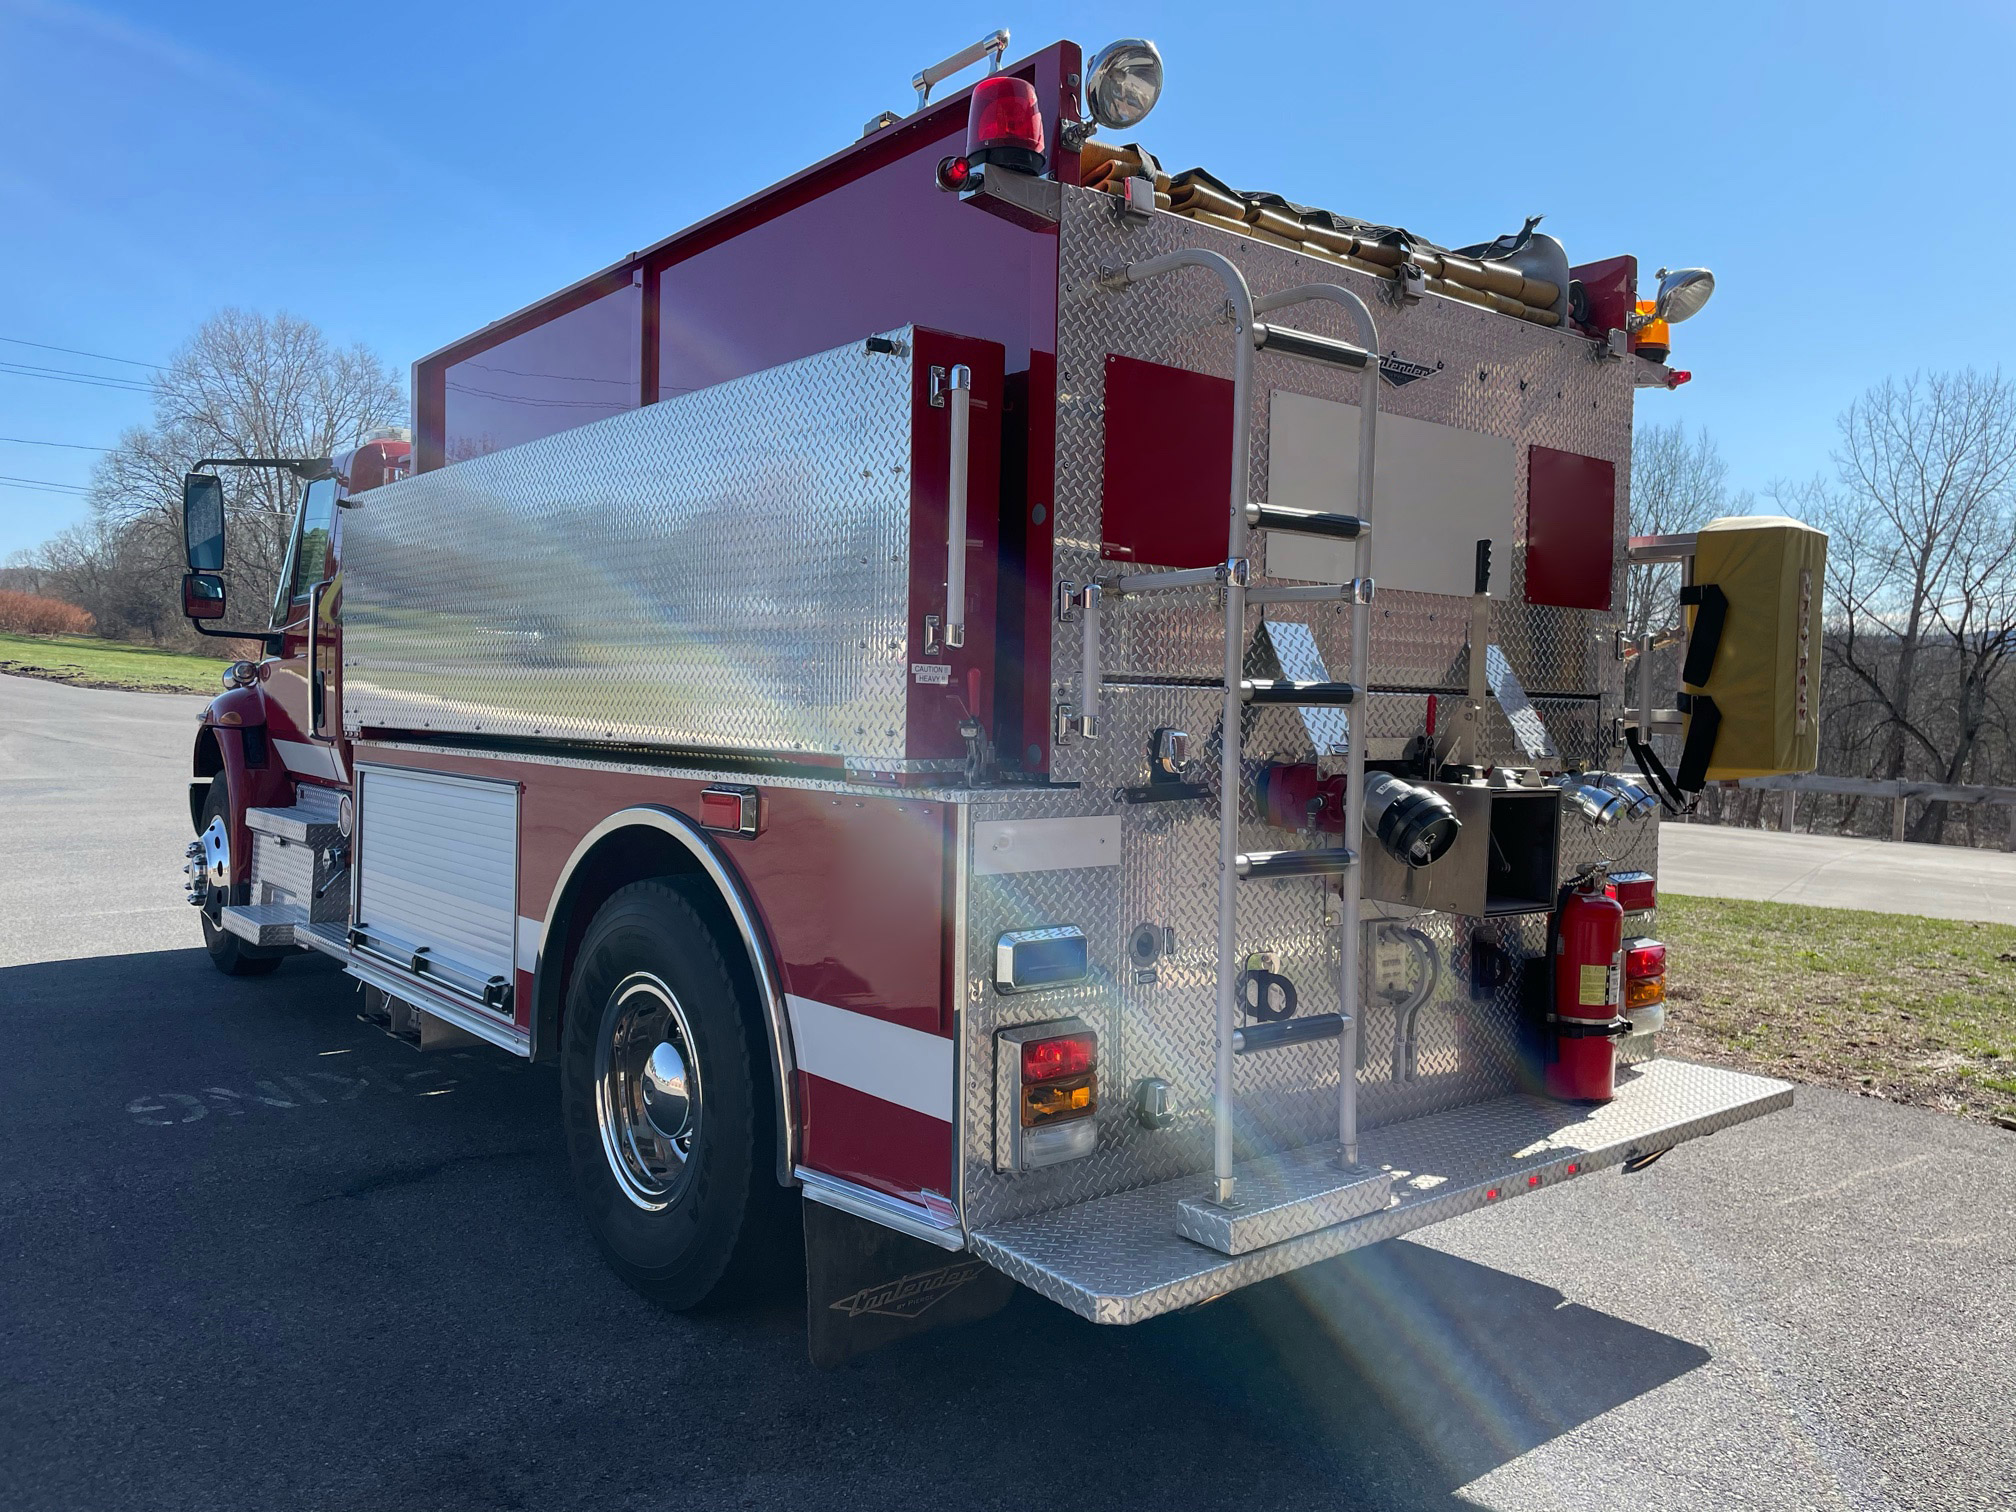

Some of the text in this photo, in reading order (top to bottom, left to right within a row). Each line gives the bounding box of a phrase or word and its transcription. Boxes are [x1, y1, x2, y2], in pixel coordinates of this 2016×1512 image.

[1378, 354, 1430, 378] ntender
[914, 665, 943, 674] CAUTION
[918, 674, 940, 682] HEAVY
[850, 1267, 977, 1317] Contender
